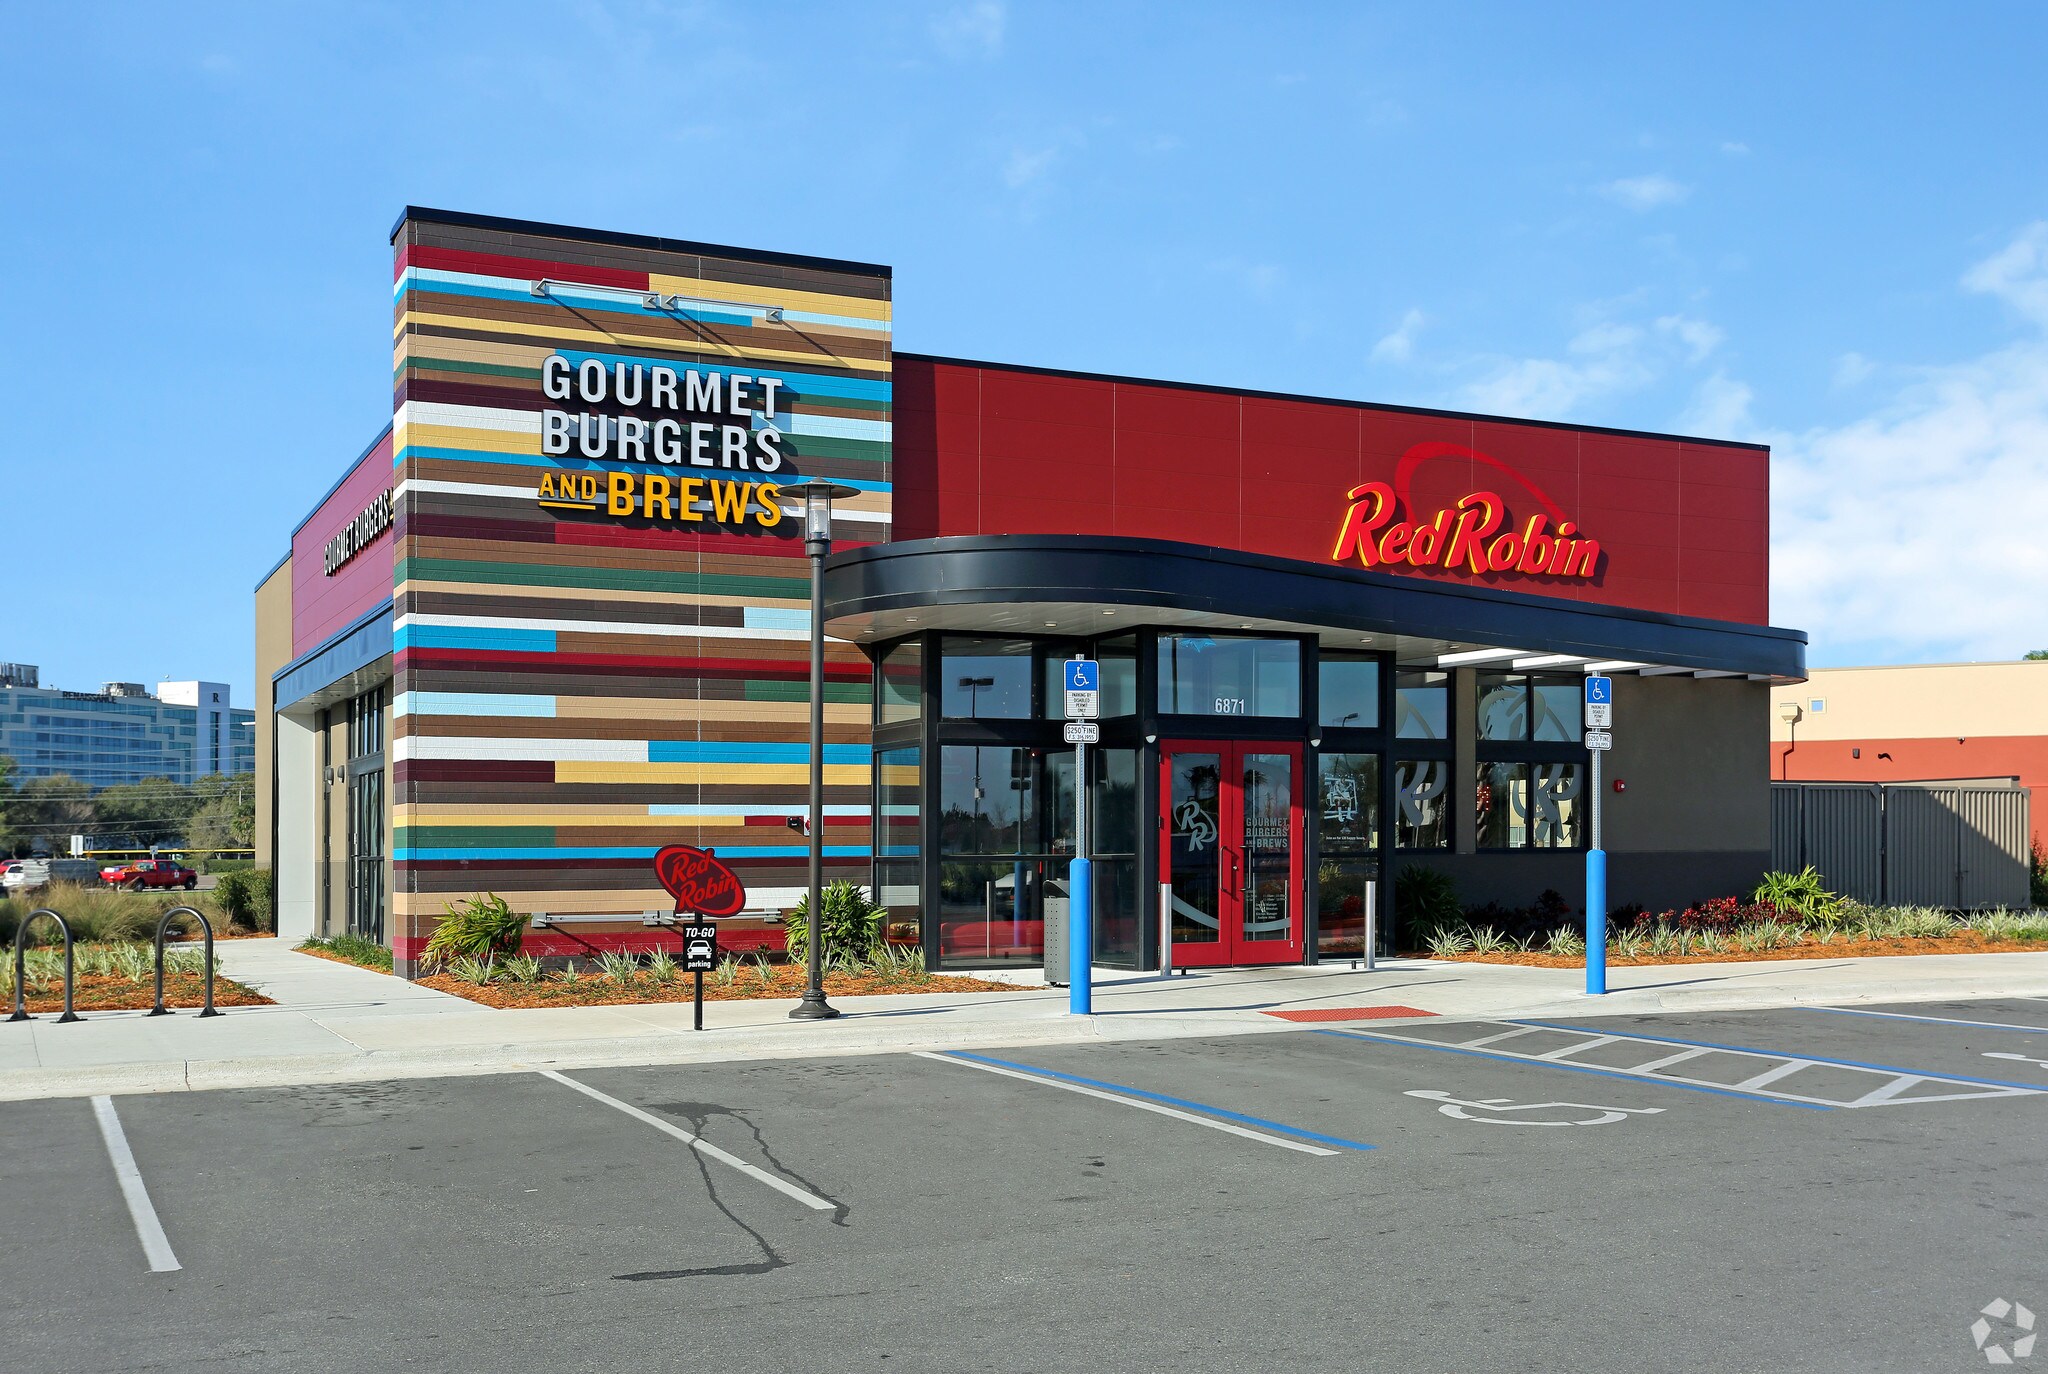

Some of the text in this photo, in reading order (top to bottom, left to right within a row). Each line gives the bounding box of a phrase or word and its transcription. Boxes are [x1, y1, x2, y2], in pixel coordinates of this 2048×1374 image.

[542, 355, 783, 419] GOURMET
[542, 409, 782, 472] BURGERS
[538, 472, 782, 527] AND BREWS
[324, 521, 354, 577] GOURMET
[354, 488, 389, 551] BURGERS
[1332, 481, 1600, 577] Red Robin
[212, 692, 220, 703] R
[1215, 697, 1245, 713] 6871
[1067, 726, 1096, 735] $250 FINE
[1246, 817, 1288, 827] GOURMET
[1246, 827, 1288, 837] BURGERS
[1256, 838, 1288, 848] BREWS
[671, 850, 714, 885] Red
[680, 875, 737, 909] Robin
[685, 927, 715, 938] TO-GO
[687, 960, 712, 970] parking
